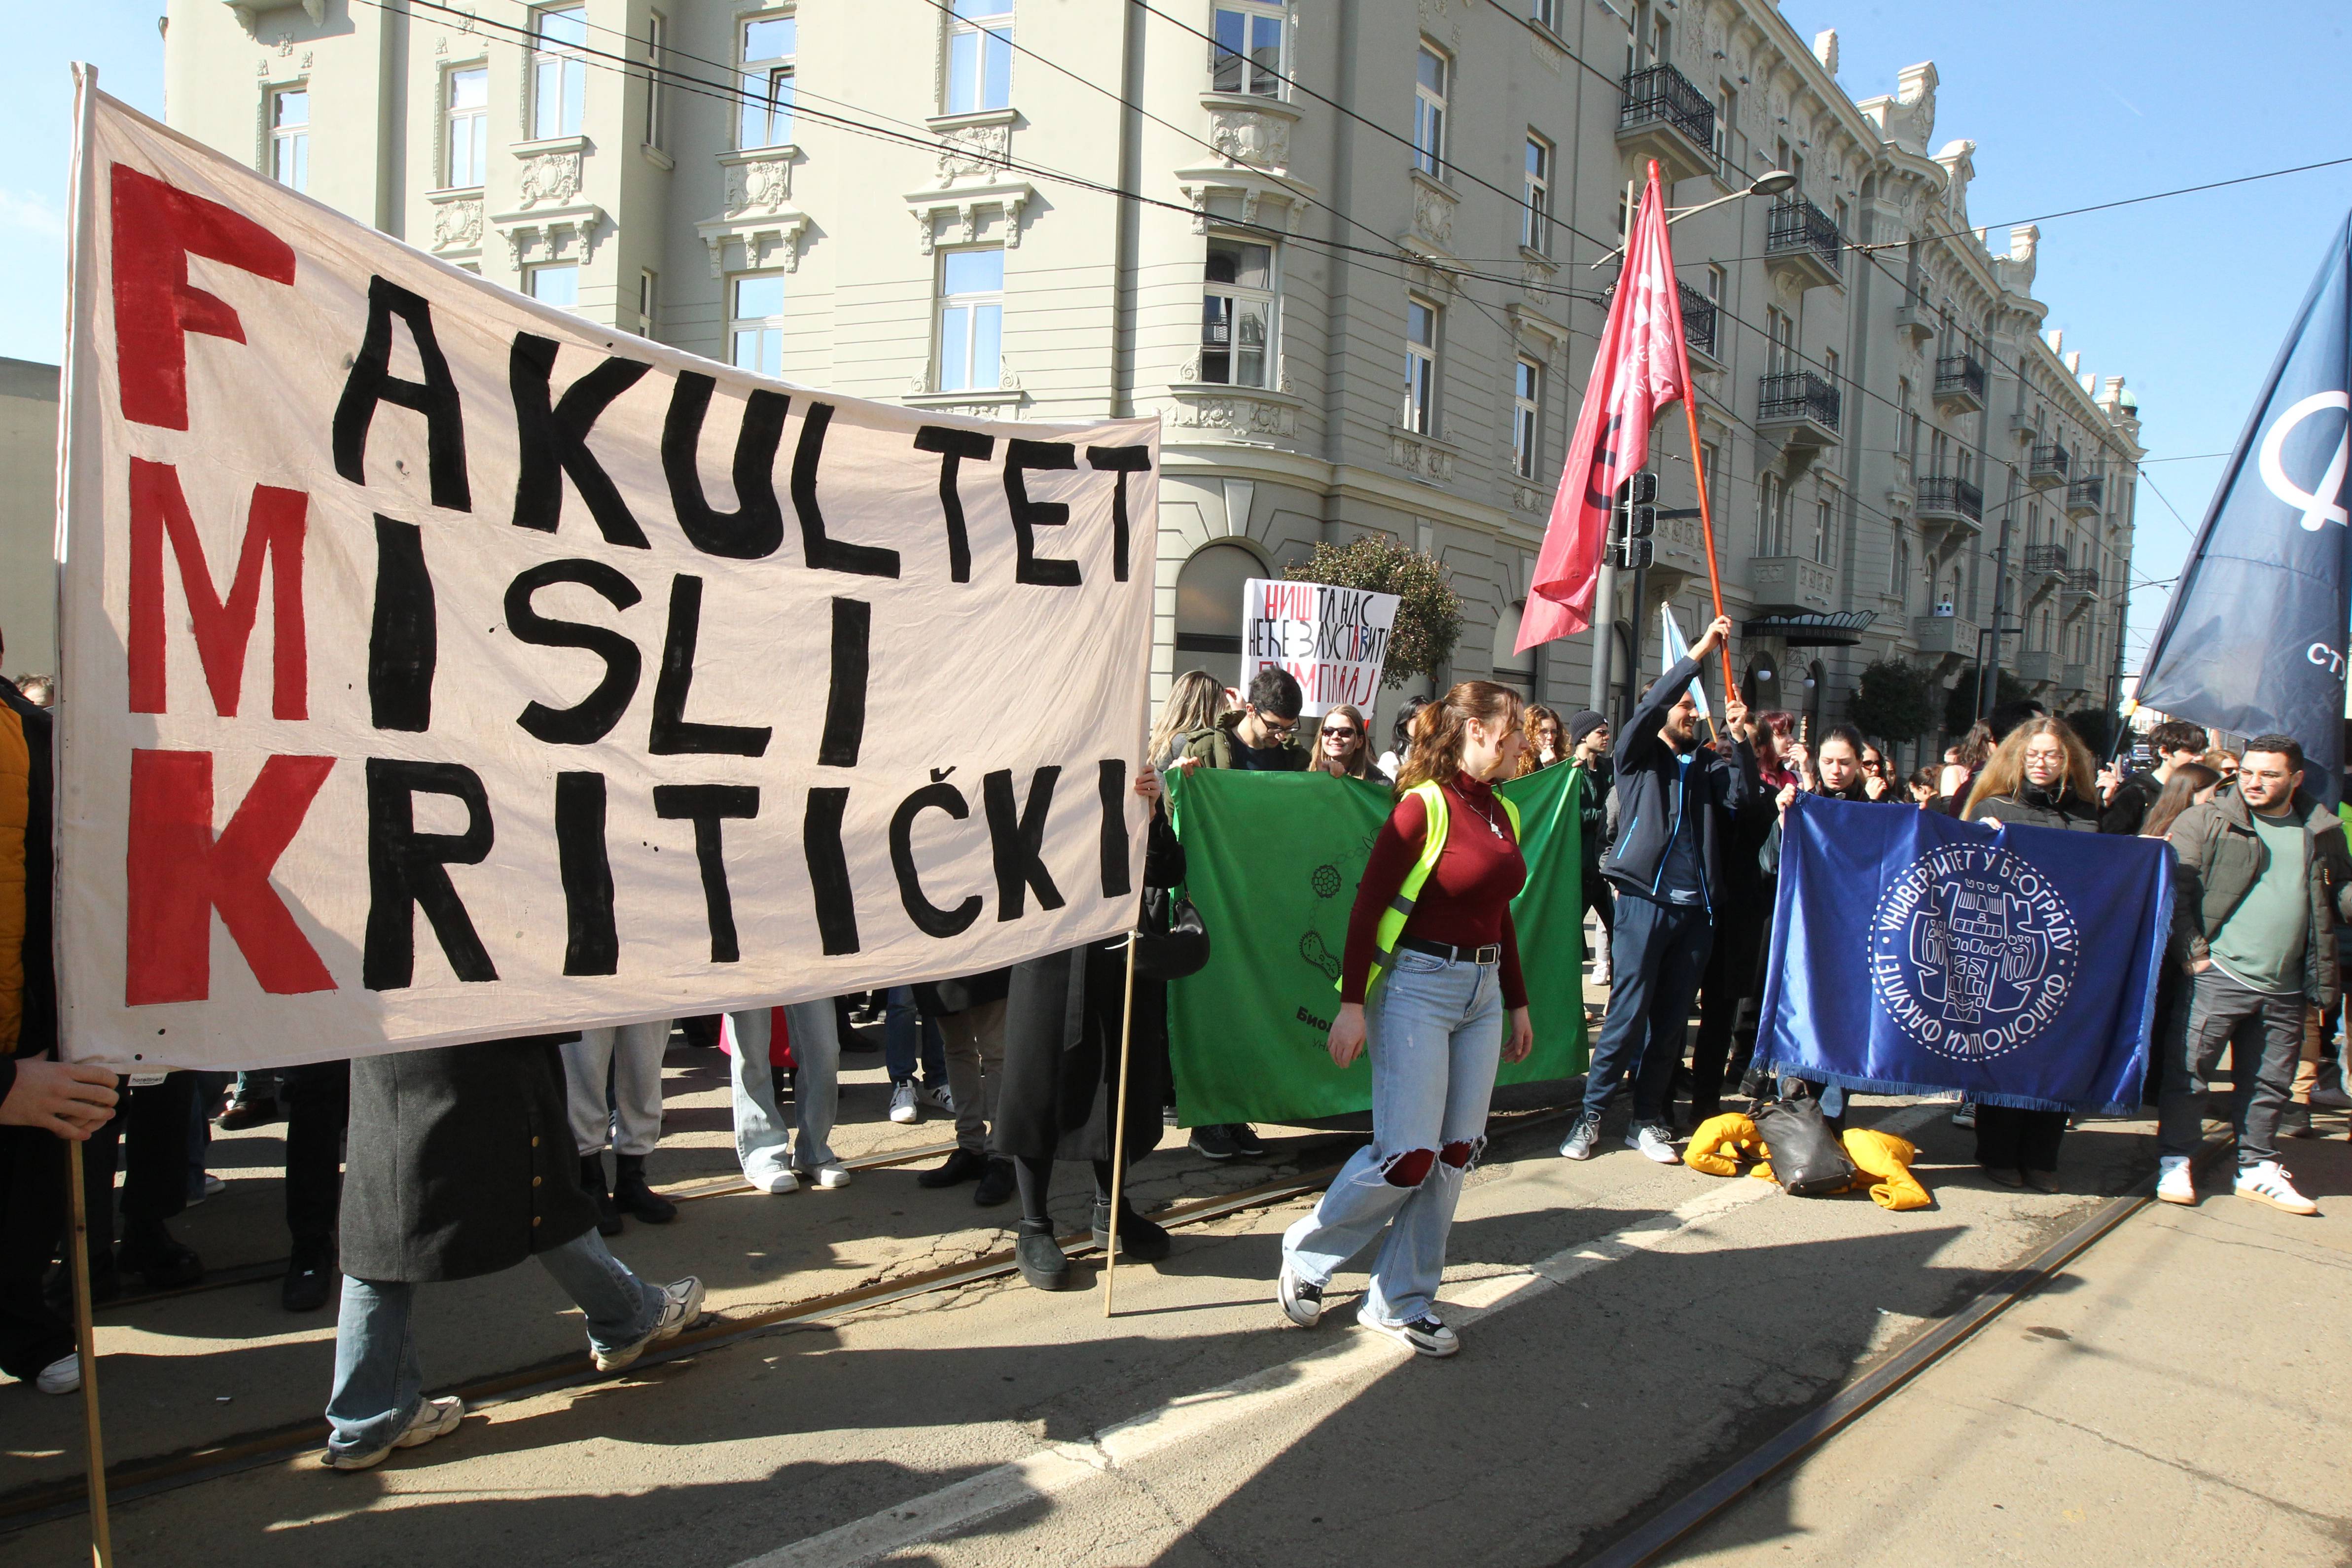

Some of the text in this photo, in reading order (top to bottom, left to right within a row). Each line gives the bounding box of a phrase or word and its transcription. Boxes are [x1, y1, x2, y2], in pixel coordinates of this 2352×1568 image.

[110, 161, 1152, 586] FAKULTET
[129, 454, 871, 768] MISLI
[1249, 618, 1289, 657] НЕЋЕ
[1341, 590, 1374, 627] НАС
[1756, 627, 1796, 636] HOTEL
[126, 748, 1132, 1007] KRITIČKI
[1879, 850, 2073, 952] УНИВЕРЗИТЕТ У БЕОГРАДУ
[1875, 952, 2066, 1054] ФИЛОЛОШКИ ФАКУЛТЕТ
